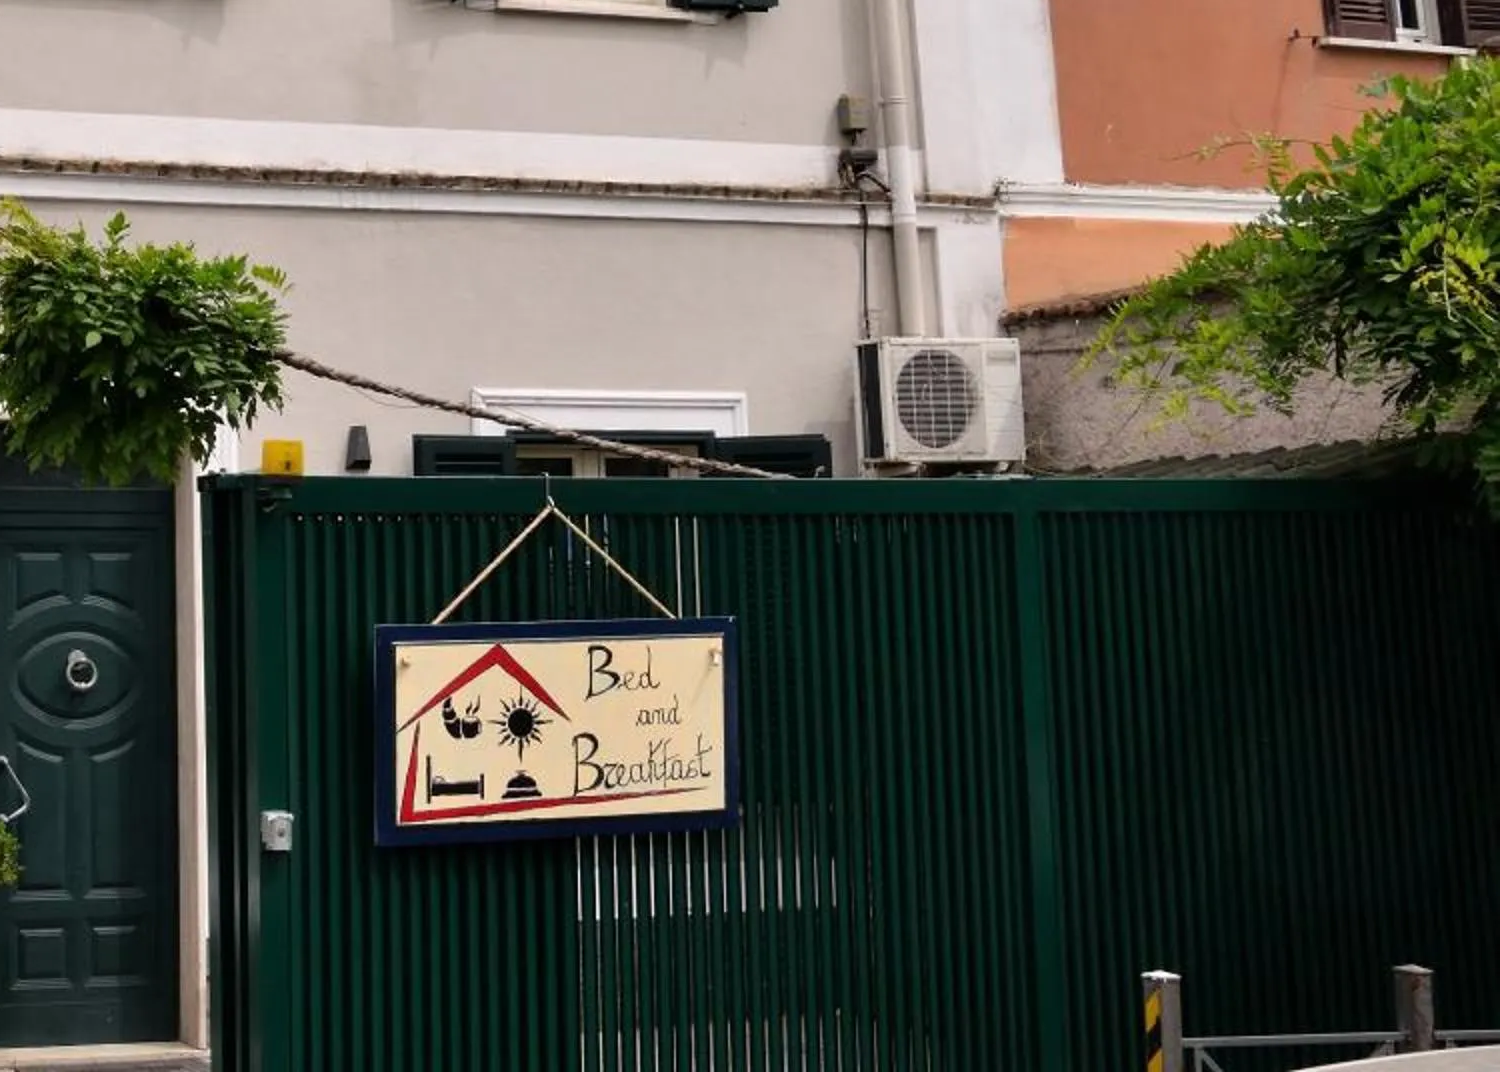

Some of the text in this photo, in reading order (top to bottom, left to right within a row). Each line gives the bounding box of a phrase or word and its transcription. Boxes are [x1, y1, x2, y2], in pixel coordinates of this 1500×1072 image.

[585, 644, 661, 701] Bed
[635, 695, 681, 727] and
[572, 732, 713, 796] Breakfast
